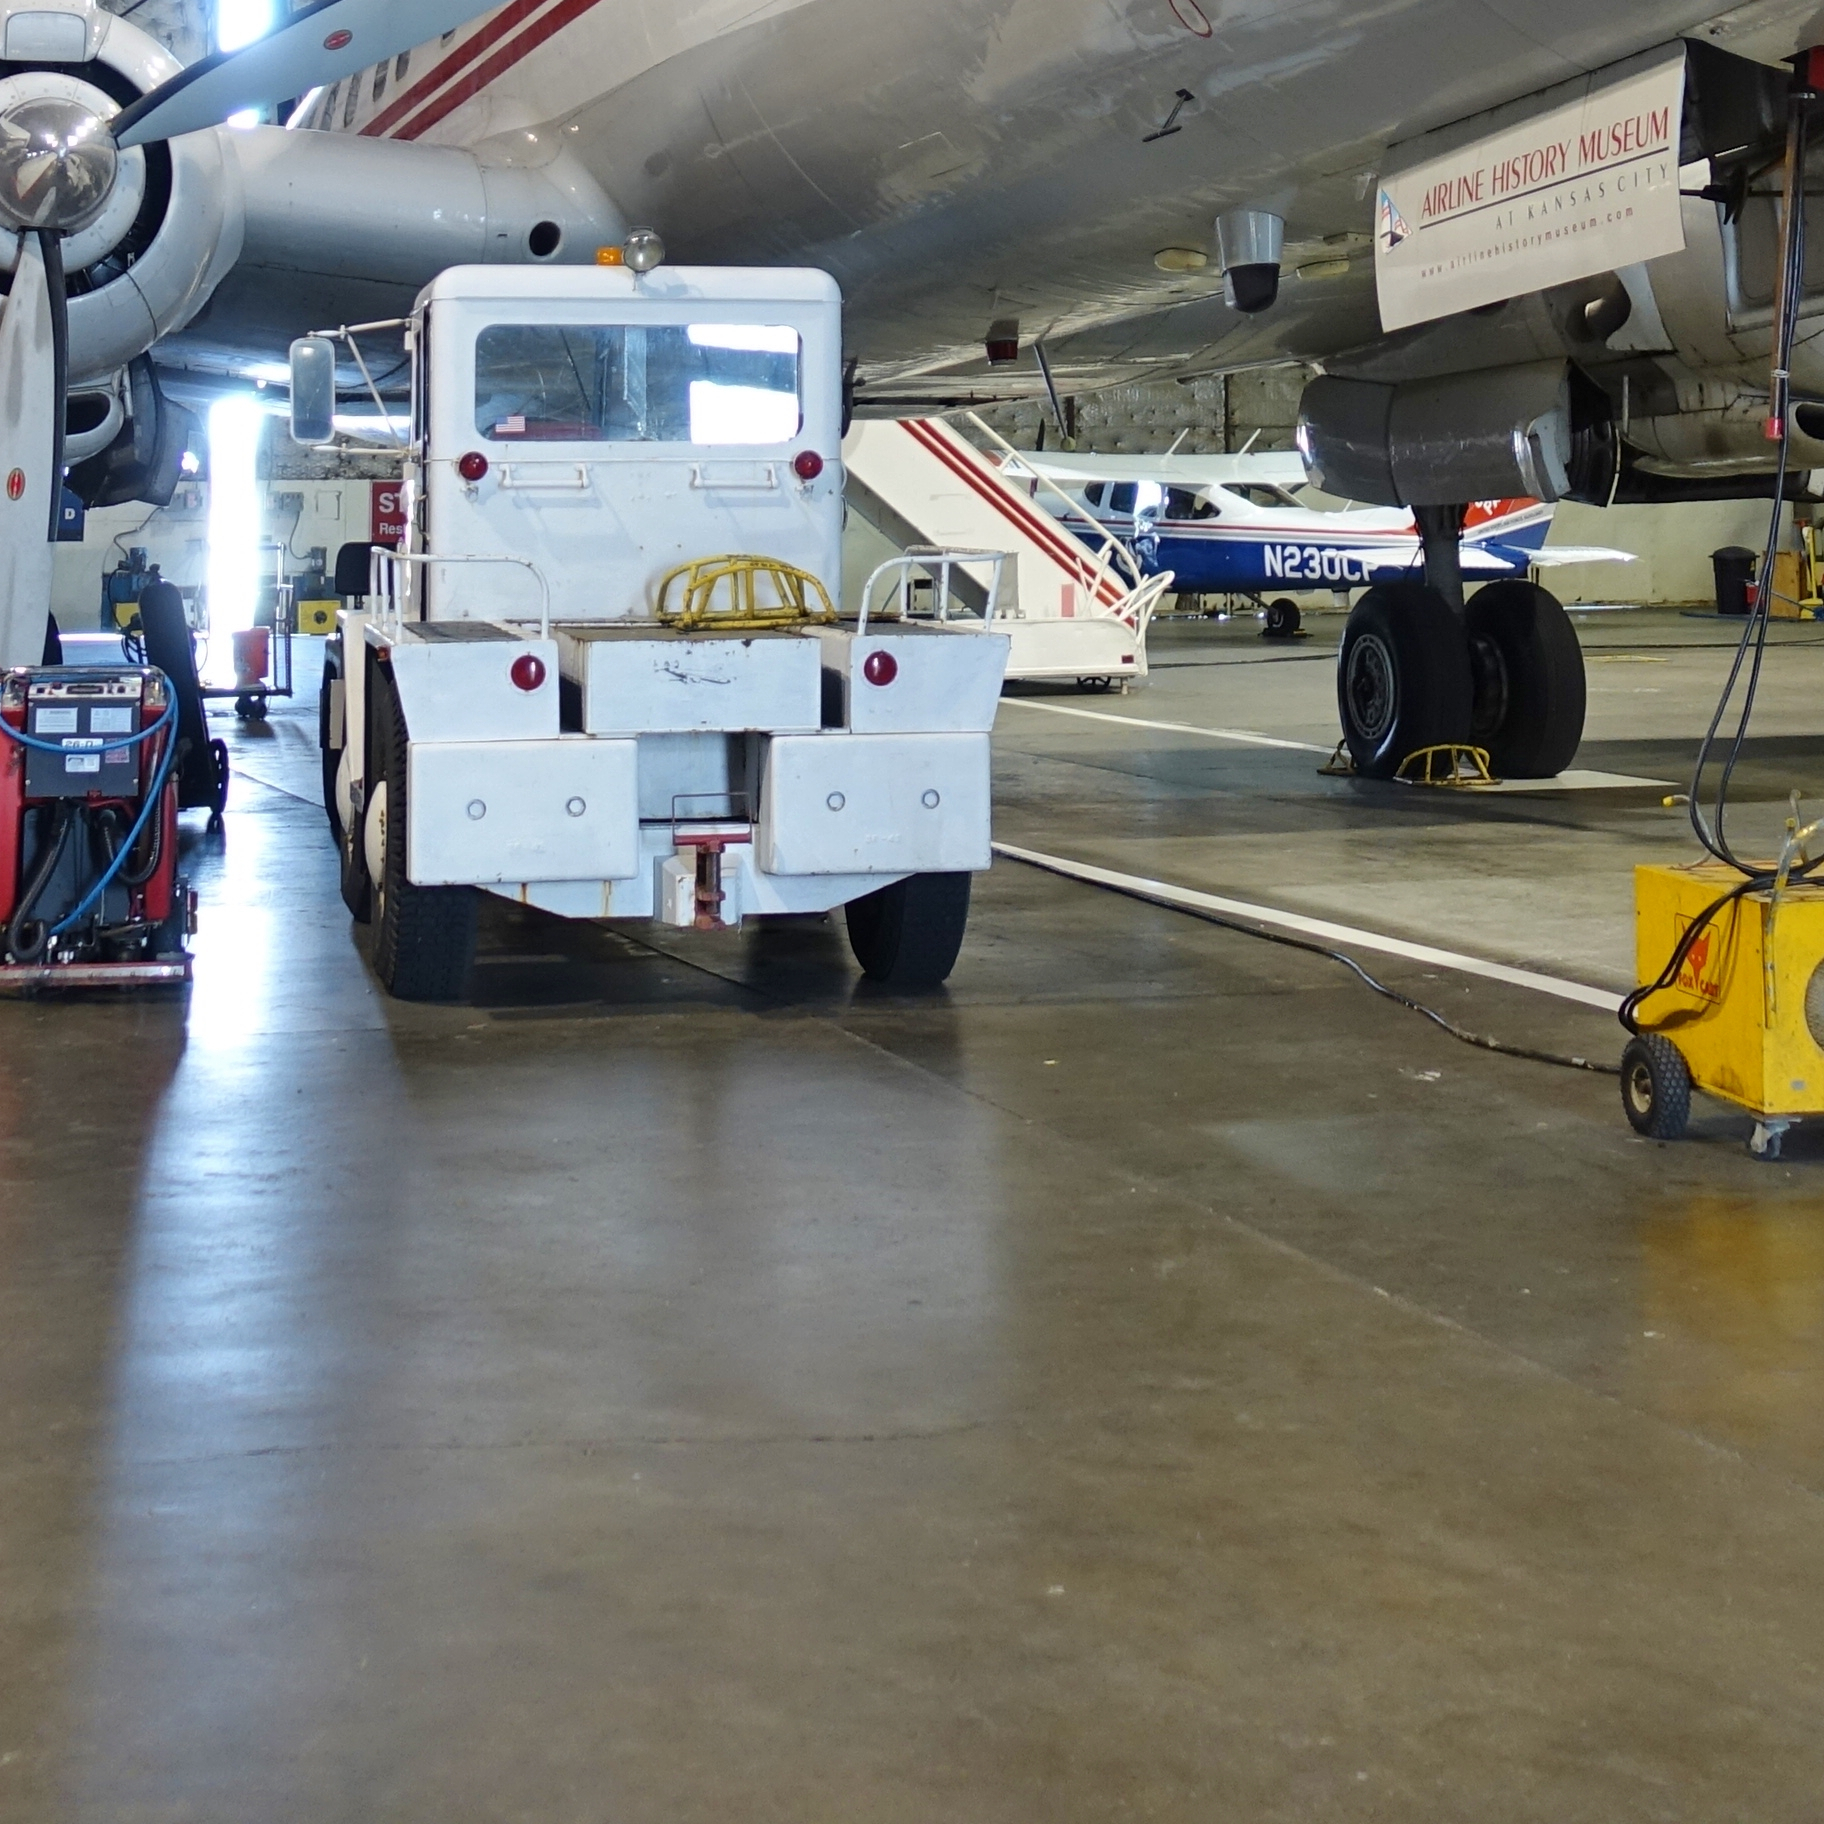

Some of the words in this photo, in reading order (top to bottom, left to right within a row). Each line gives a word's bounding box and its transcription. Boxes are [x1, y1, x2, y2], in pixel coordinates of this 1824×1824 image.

[1420, 168, 1486, 220] AIRLINE
[1491, 138, 1573, 196] HISTORY
[1578, 106, 1670, 169] MUSEUM
[1495, 208, 1515, 231] AT
[1527, 181, 1606, 221] KANSAS
[1617, 162, 1670, 193] CITY
[1421, 205, 1634, 279] www.airlinehistorymuseum.com
